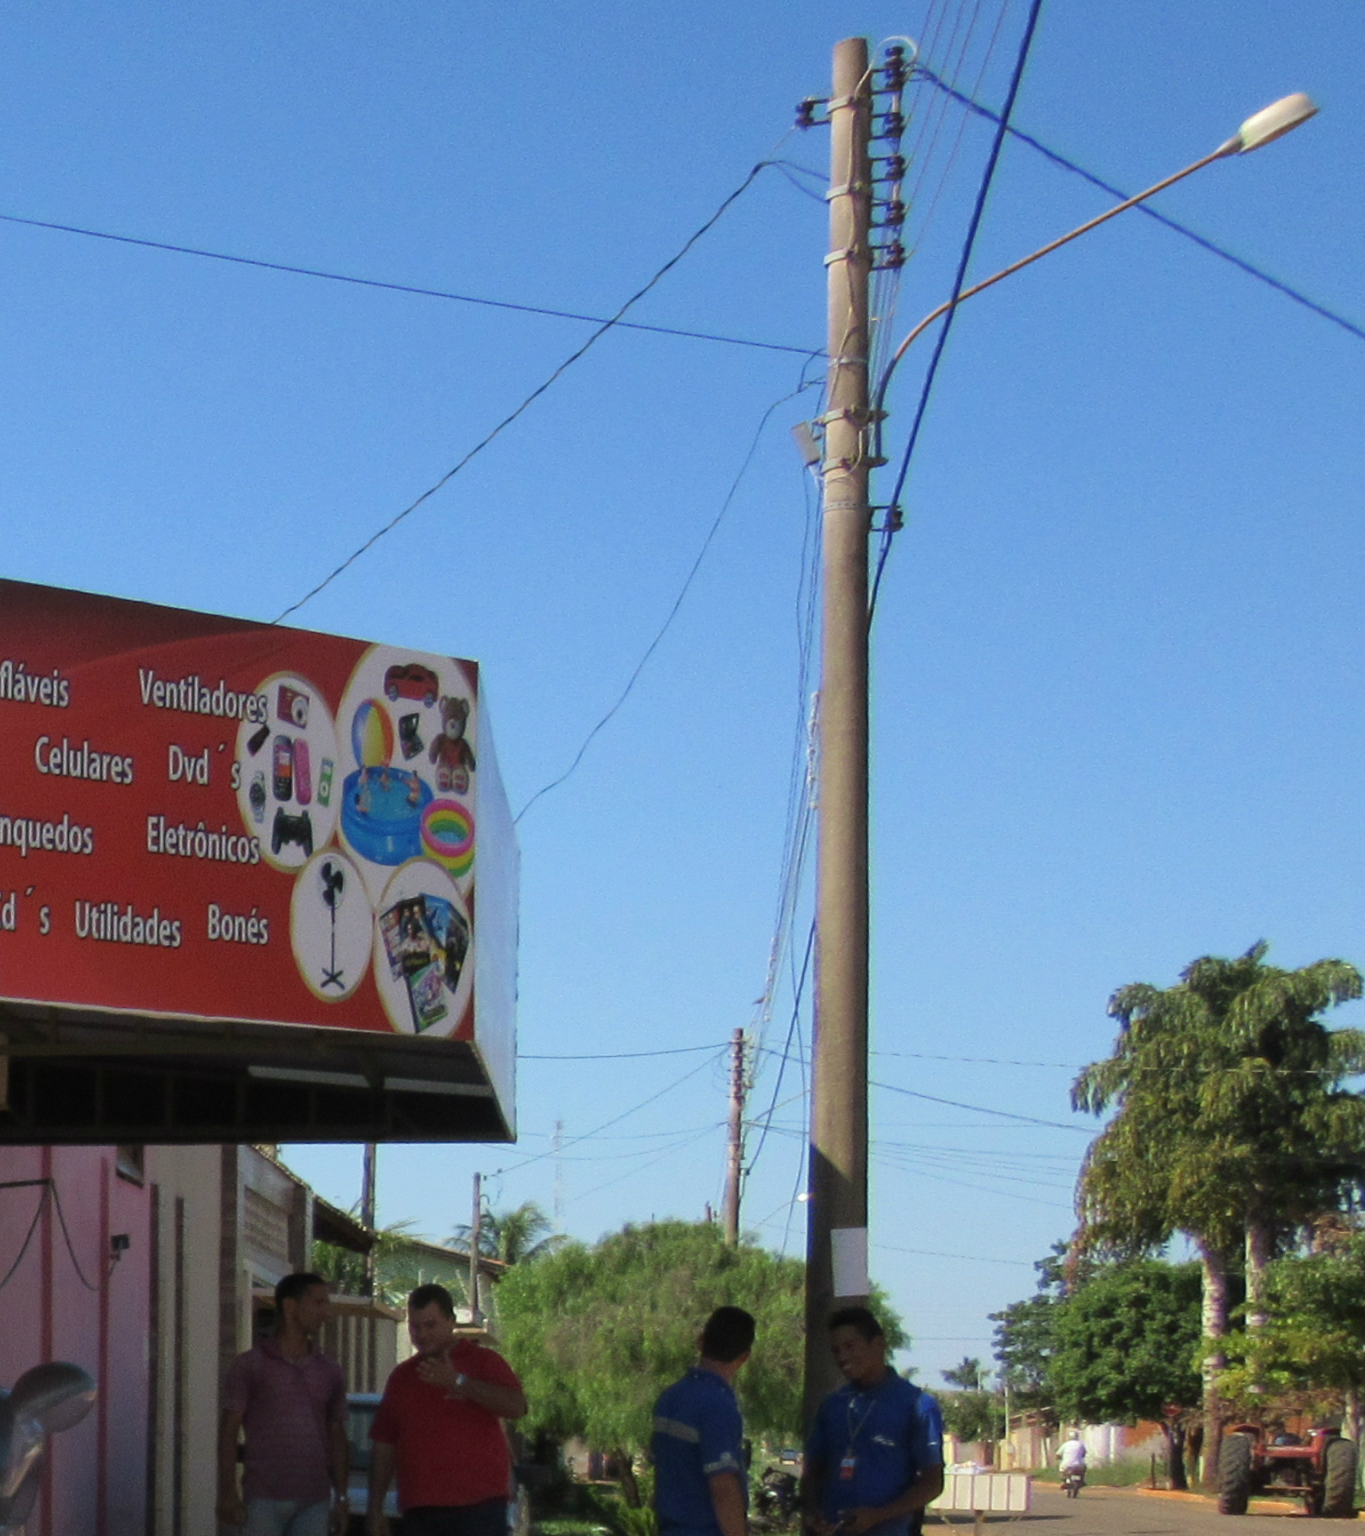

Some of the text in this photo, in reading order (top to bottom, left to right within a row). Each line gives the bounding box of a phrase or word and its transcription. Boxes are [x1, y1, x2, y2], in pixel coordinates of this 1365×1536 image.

[139, 669, 269, 725] Ventiladores
[35, 736, 133, 785] Celulares
[147, 817, 260, 864] Eletrônicos
[75, 901, 181, 948] Utilidades
[207, 904, 268, 945] Bonés
